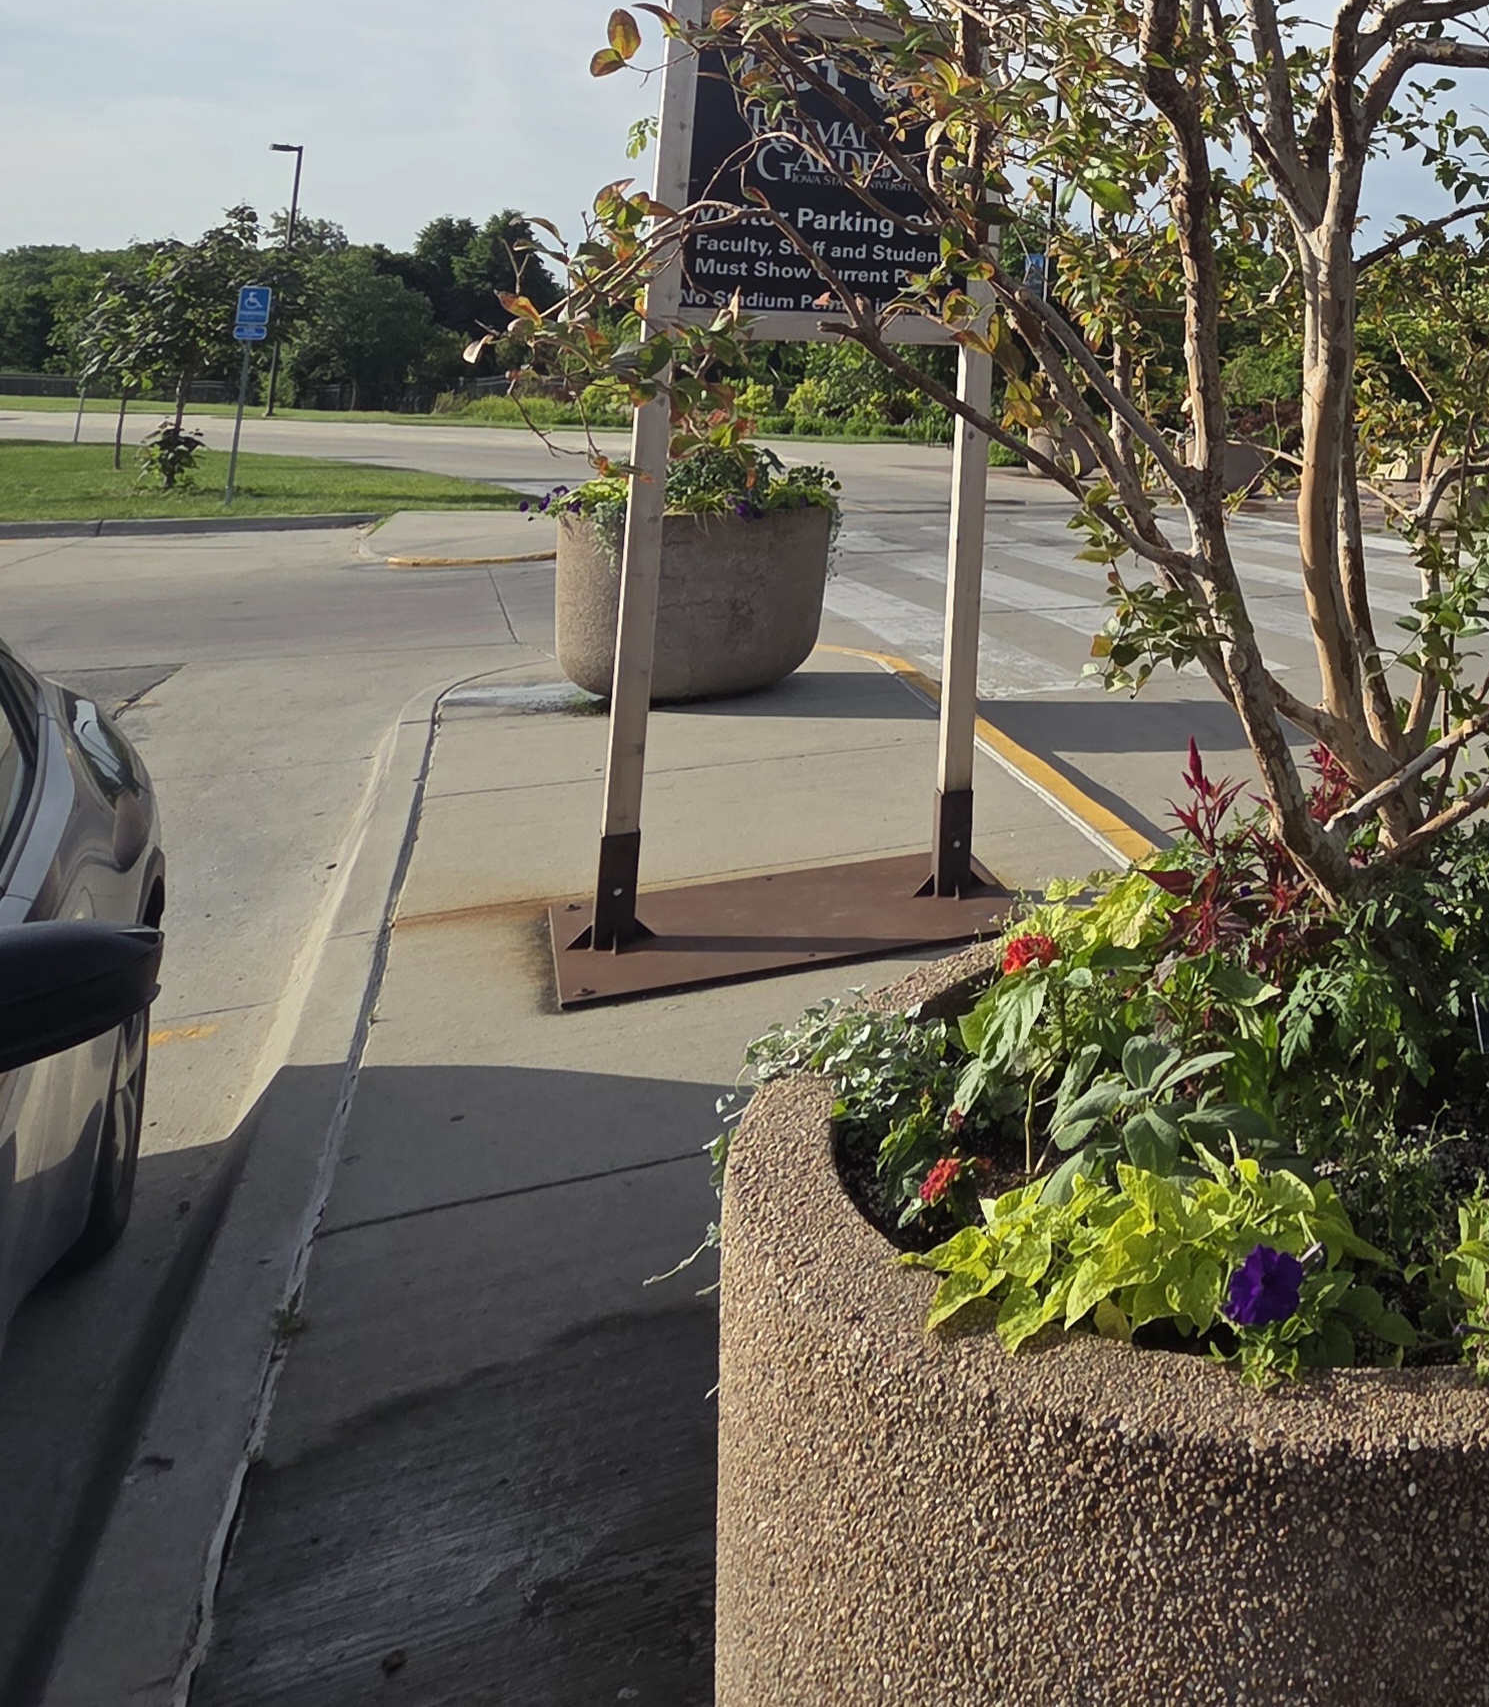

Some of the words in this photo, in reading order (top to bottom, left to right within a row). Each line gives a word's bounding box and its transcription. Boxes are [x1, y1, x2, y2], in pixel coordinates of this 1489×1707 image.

[792, 173, 821, 185] IOWA
[797, 207, 895, 239] Parking
[696, 234, 772, 257] Faculty,
[778, 239, 827, 257] Stff
[830, 244, 867, 260] and
[695, 257, 748, 276] Must
[754, 261, 811, 279] Show
[679, 289, 707, 305] No
